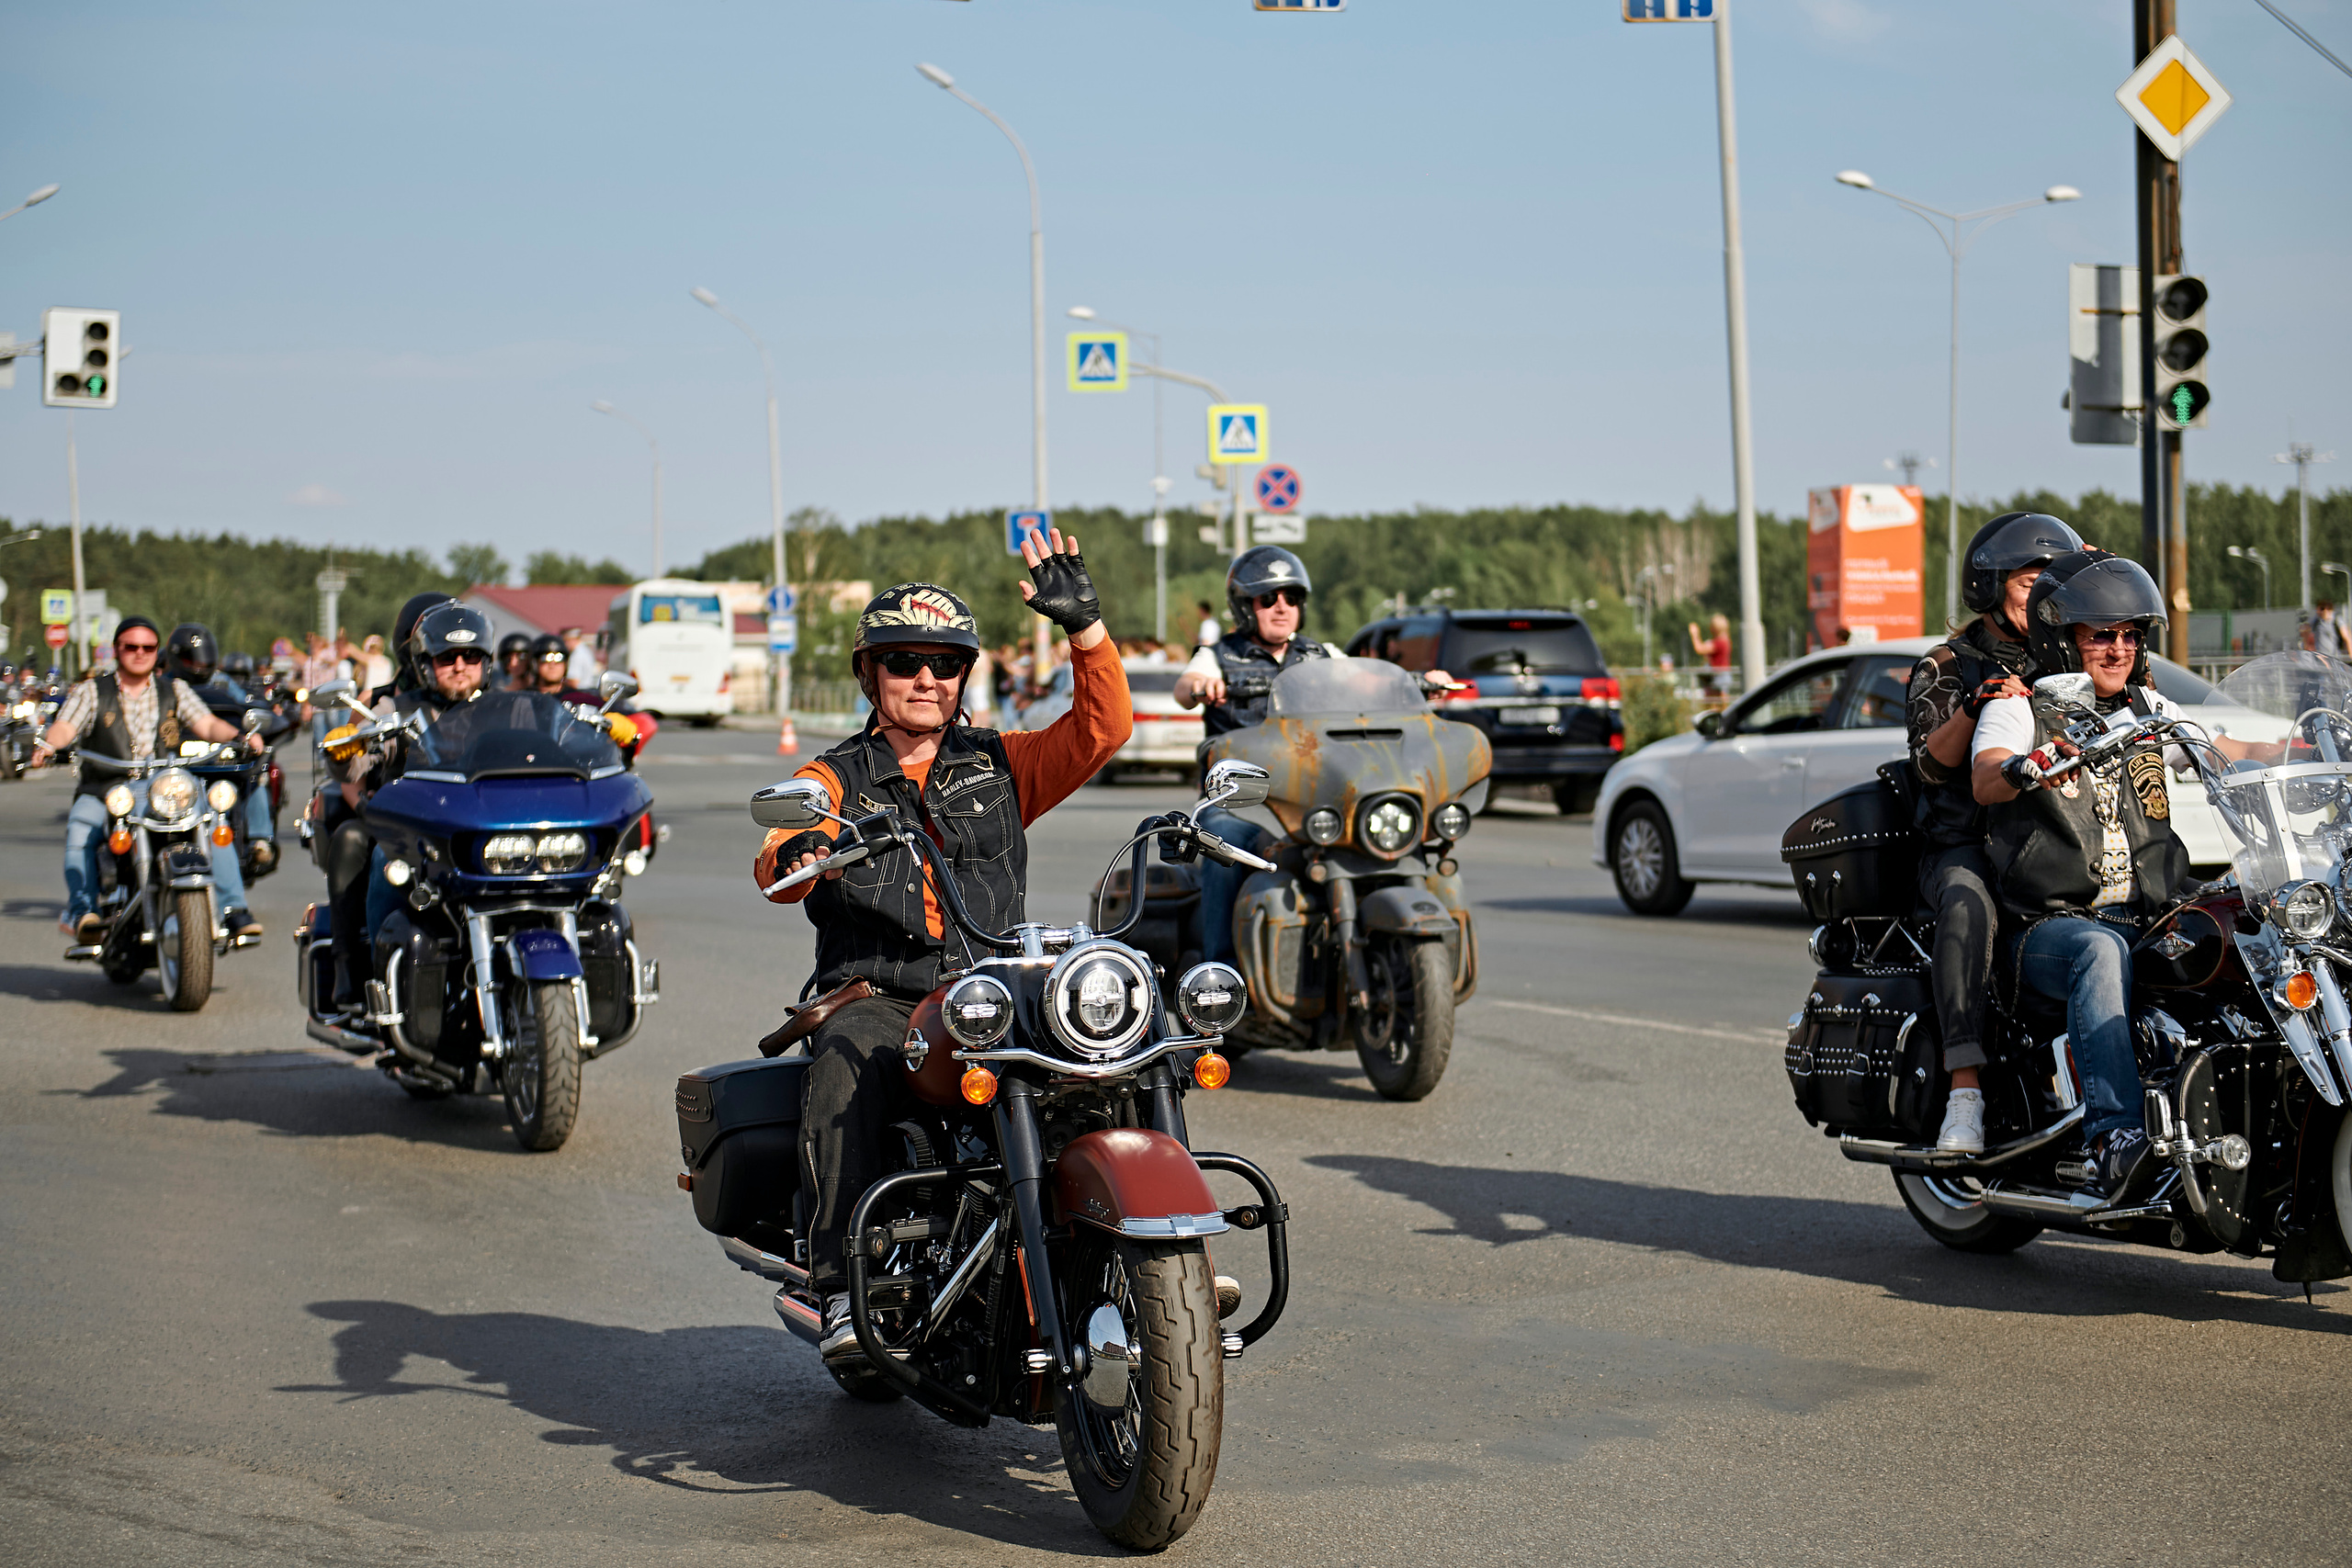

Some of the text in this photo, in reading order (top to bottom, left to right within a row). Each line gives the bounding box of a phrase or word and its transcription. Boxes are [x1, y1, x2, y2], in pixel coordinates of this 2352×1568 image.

[2132, 758, 2145, 769] LIFE
[941, 772, 996, 797] HARLEY-DAVIDSON
[865, 799, 886, 812] OLEG
